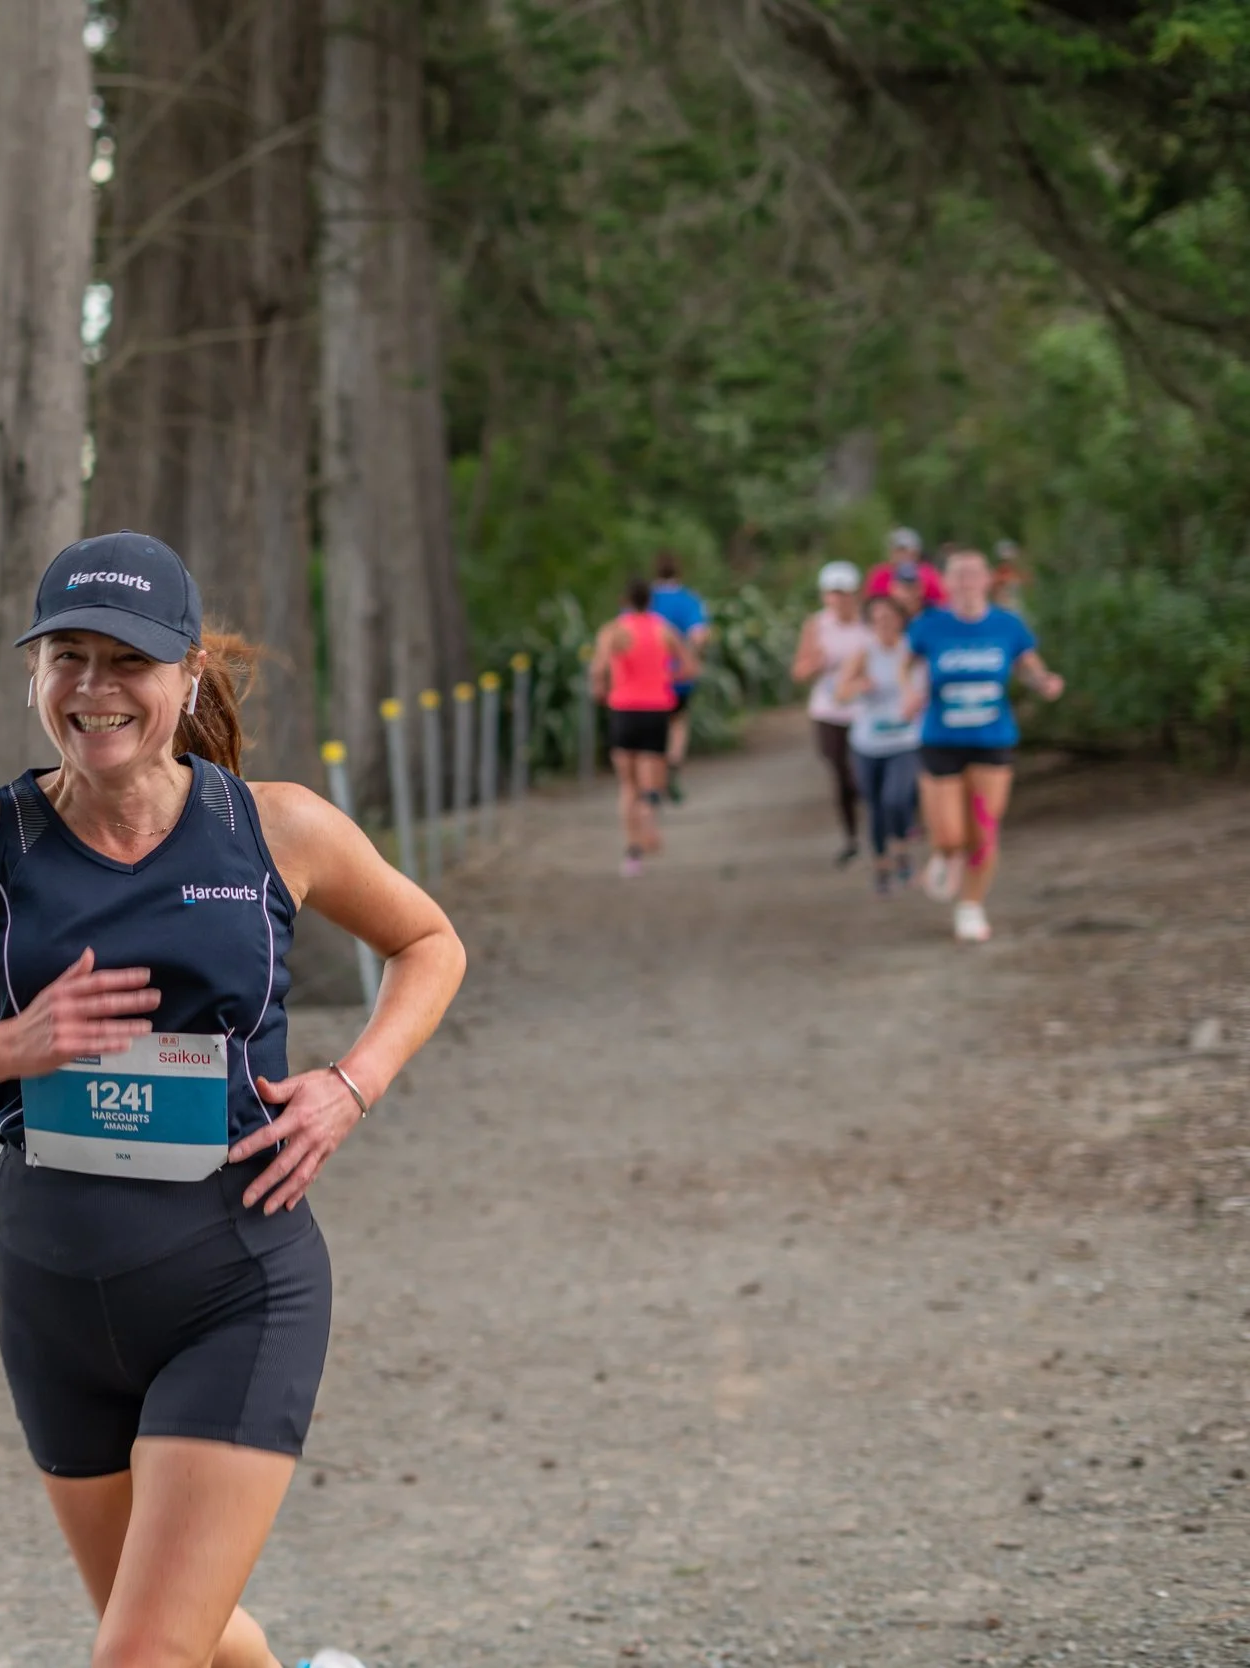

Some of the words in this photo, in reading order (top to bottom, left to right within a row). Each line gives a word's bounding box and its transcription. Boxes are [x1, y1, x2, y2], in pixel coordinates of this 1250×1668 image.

[67, 572, 151, 591] Harcourts
[182, 884, 257, 900] Harcourts
[159, 1050, 210, 1064] saikou
[86, 1081, 152, 1112] 1241
[92, 1111, 150, 1124] HARCOURTS
[103, 1122, 139, 1132] AMANDA
